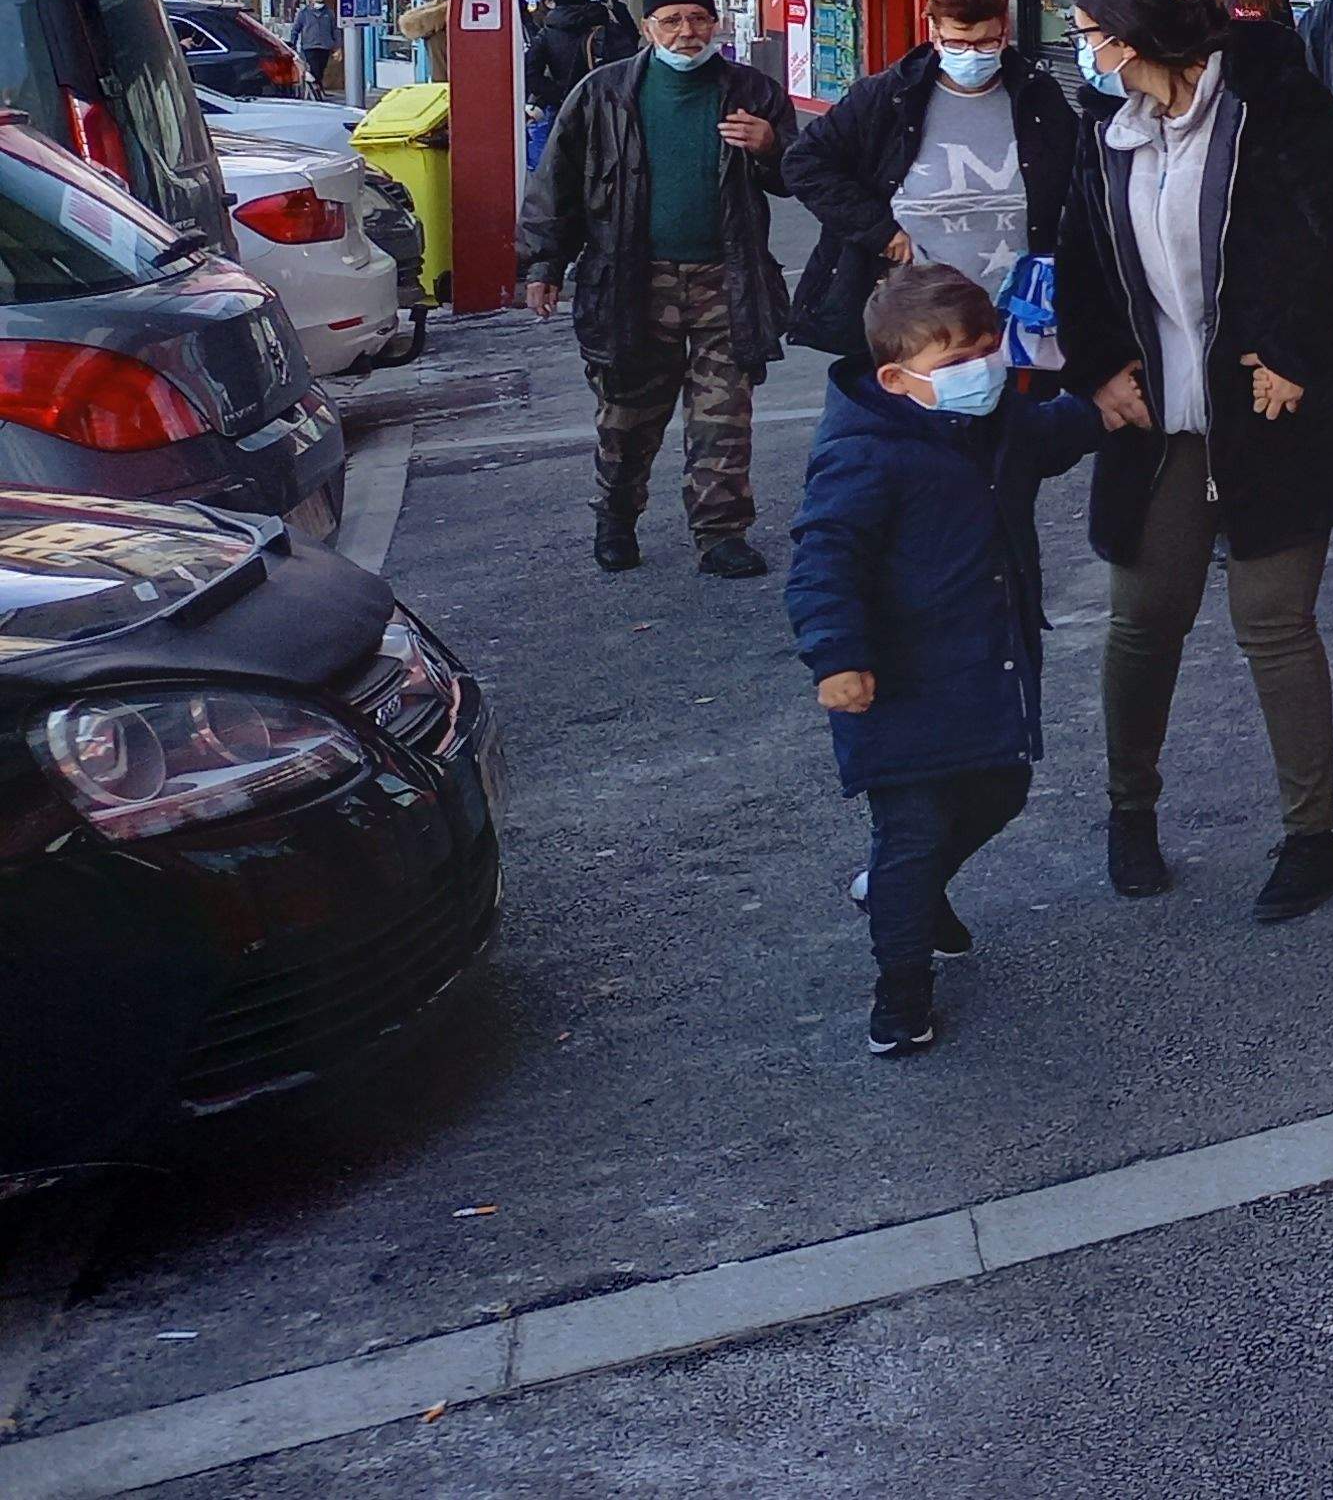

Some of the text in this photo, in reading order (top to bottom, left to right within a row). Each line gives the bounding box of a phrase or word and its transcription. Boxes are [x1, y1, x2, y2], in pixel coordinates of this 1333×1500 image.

[471, 2, 490, 22] P
[942, 212, 1017, 234] M K
